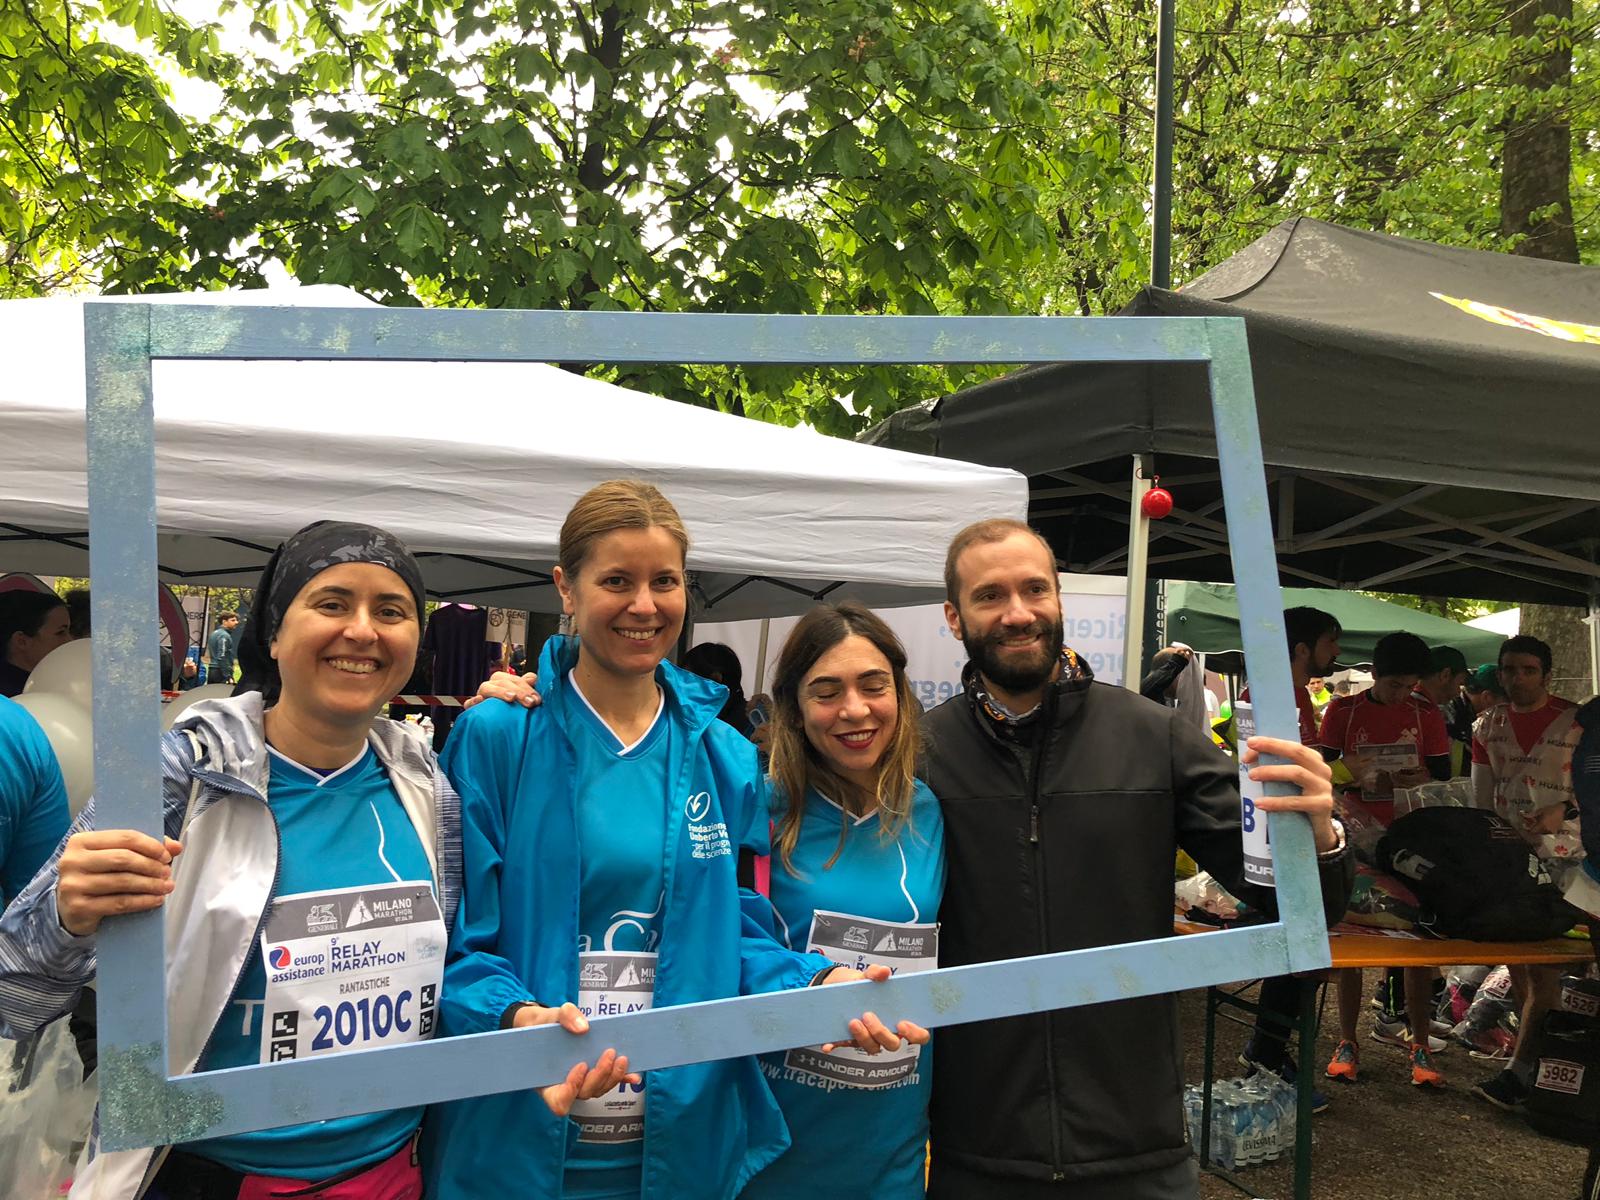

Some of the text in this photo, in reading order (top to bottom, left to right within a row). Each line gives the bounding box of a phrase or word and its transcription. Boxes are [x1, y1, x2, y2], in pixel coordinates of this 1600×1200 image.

[373, 898, 412, 912] MILANO
[374, 908, 413, 919] MARATHON
[331, 940, 382, 960] RELAY
[898, 937, 924, 946] MILANO
[294, 954, 325, 967] europ
[331, 951, 406, 973] MARATHON
[272, 967, 326, 983] assistance
[339, 976, 391, 995] RANTASTICHE
[311, 989, 413, 1052] 2010C
[817, 1060, 909, 1078] UNDER ARMOUR
[1543, 1066, 1579, 1083] 5982
